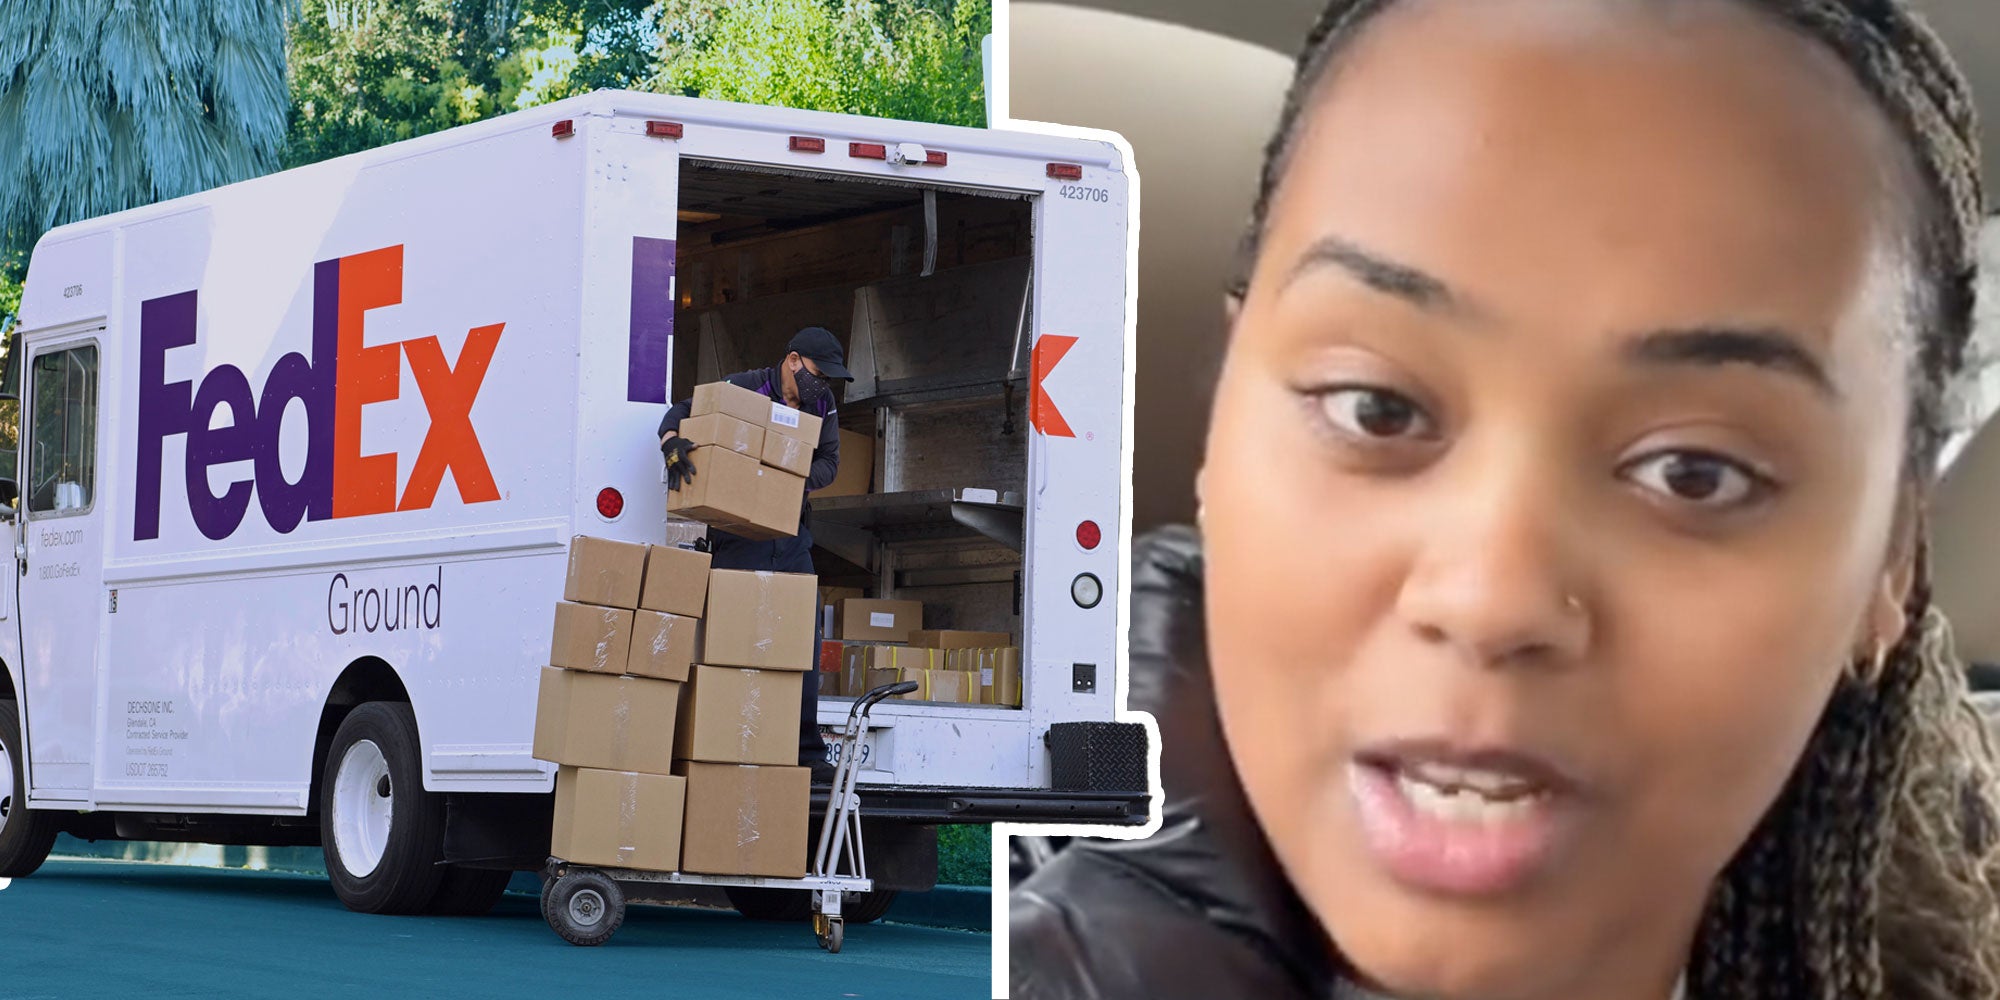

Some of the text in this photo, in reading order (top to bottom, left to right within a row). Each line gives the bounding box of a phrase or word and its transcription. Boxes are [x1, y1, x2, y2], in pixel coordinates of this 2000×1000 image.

[1059, 184, 1109, 203] 423706
[133, 243, 506, 541] FedEx
[40, 527, 84, 548] fedex.com
[328, 565, 442, 636] Ground
